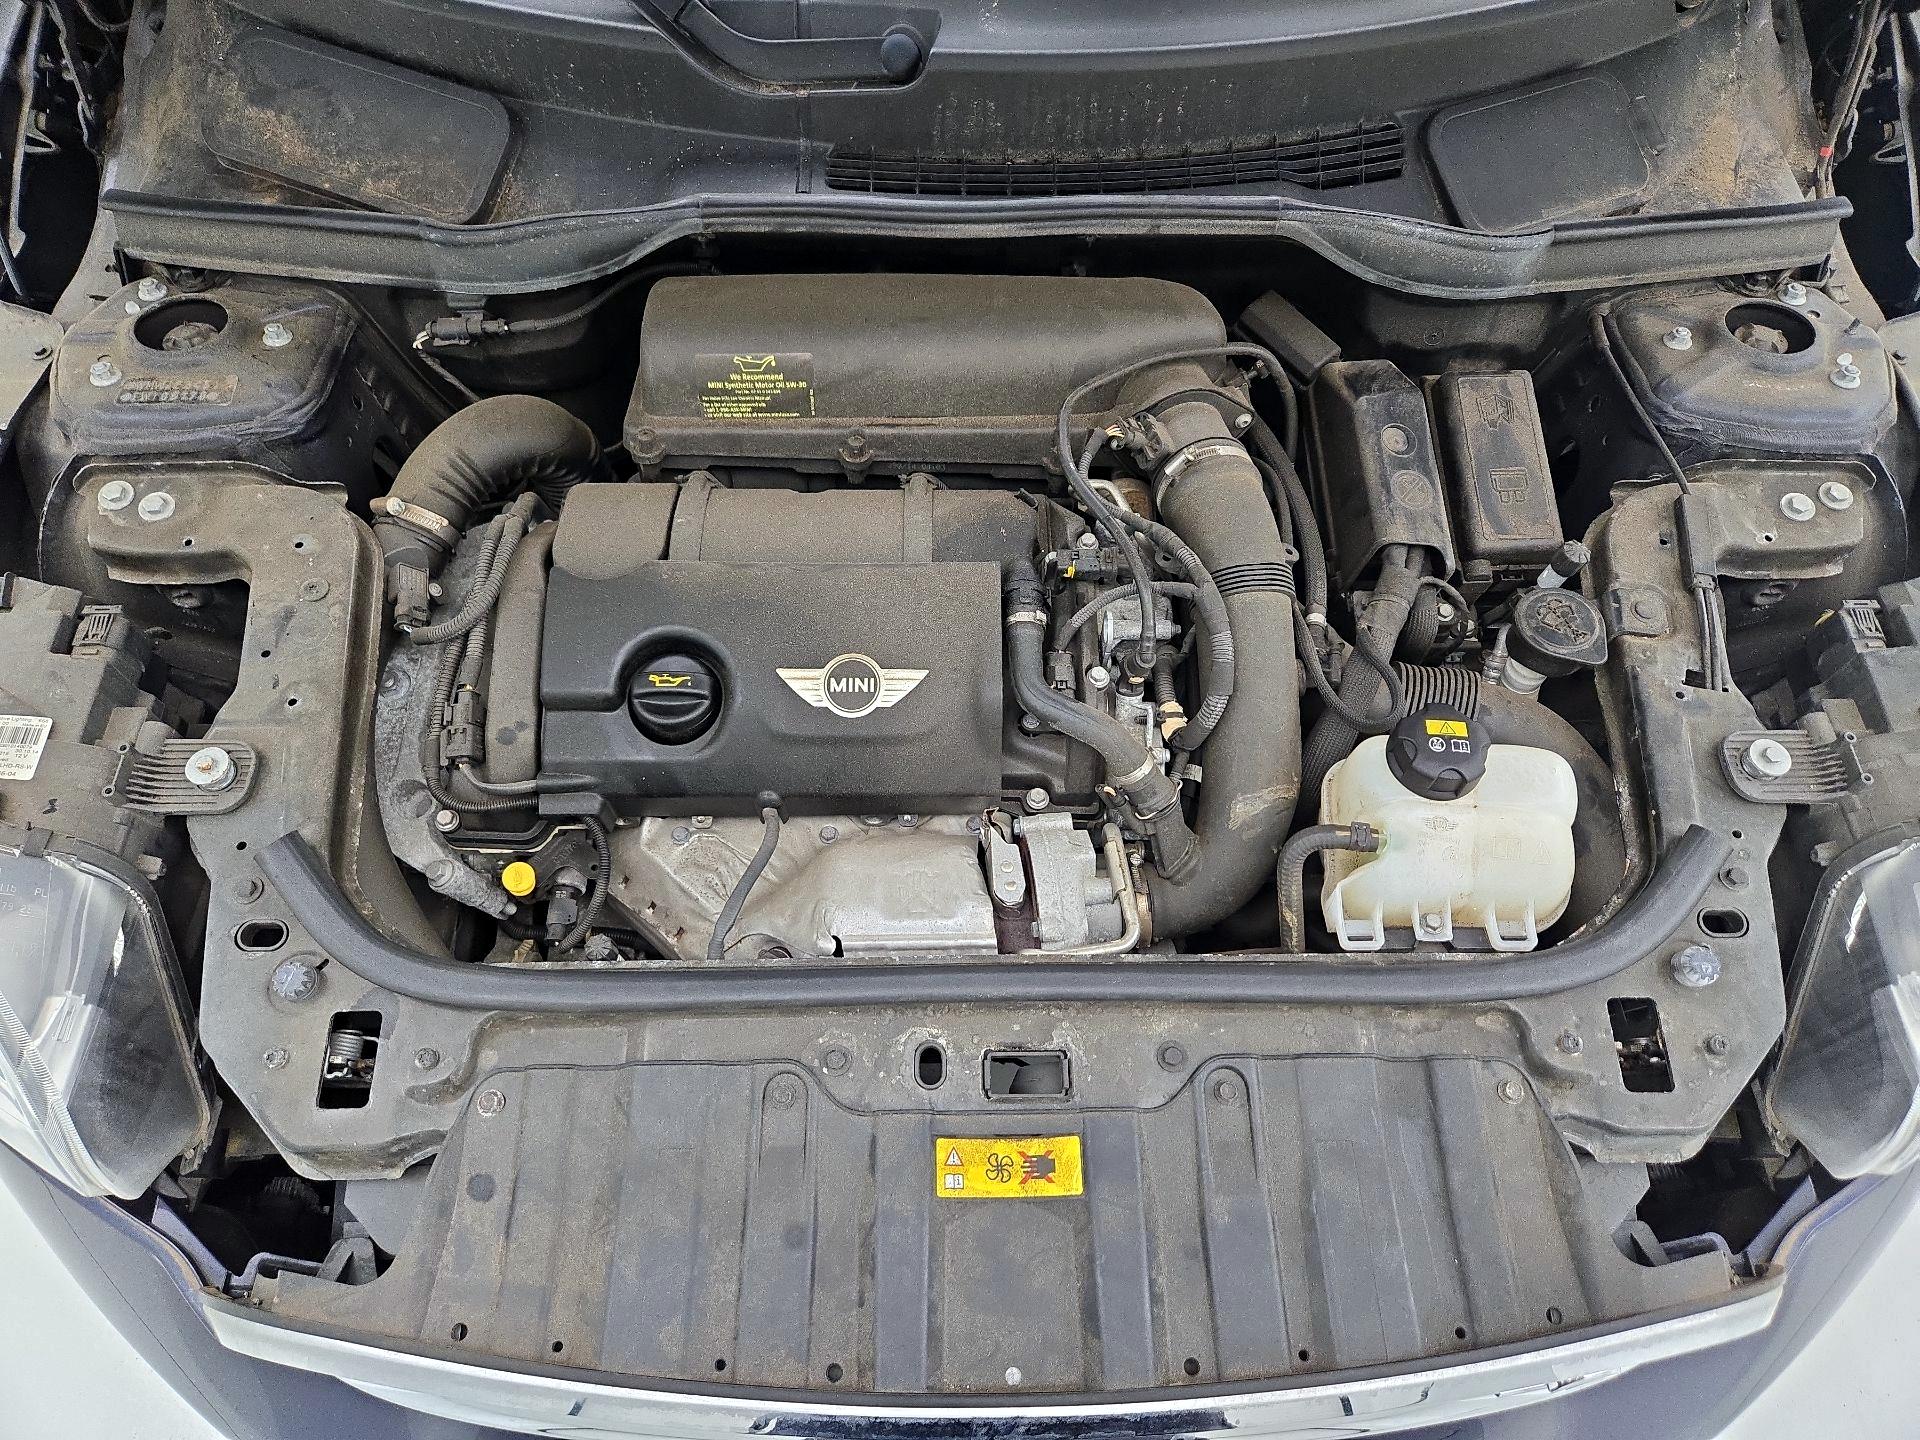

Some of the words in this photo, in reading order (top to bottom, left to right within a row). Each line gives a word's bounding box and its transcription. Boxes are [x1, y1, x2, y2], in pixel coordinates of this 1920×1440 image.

[742, 372, 784, 380] Recommend
[724, 382, 754, 390] Synthetic
[828, 676, 876, 693] MINI
